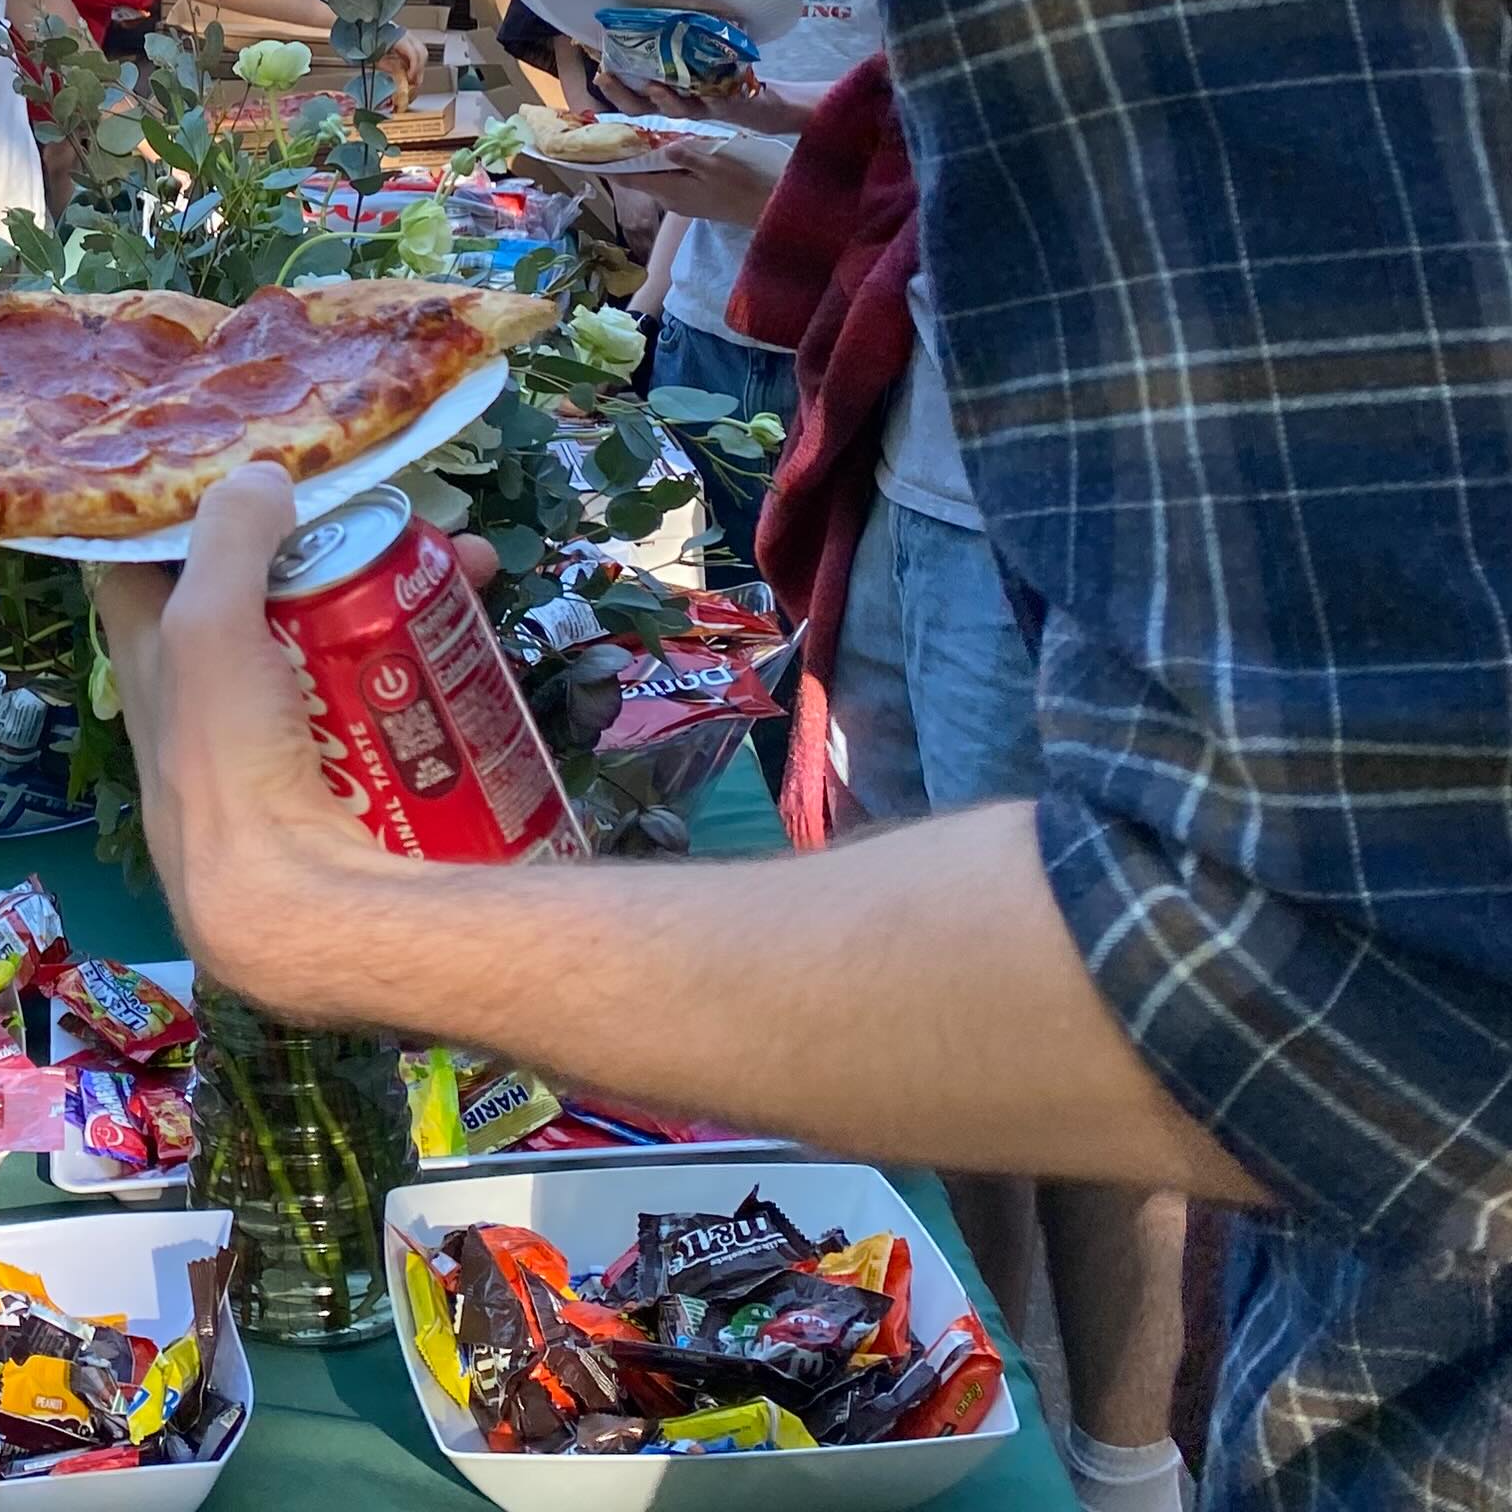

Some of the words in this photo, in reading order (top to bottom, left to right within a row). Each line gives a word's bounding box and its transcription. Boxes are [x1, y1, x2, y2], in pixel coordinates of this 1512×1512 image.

[802, 5, 853, 19] ING
[348, 721, 392, 792] TASTE
[386, 795, 424, 863] GINAL
[462, 1085, 530, 1131] HARIB
[35, 1394, 63, 1411] PEANUT
